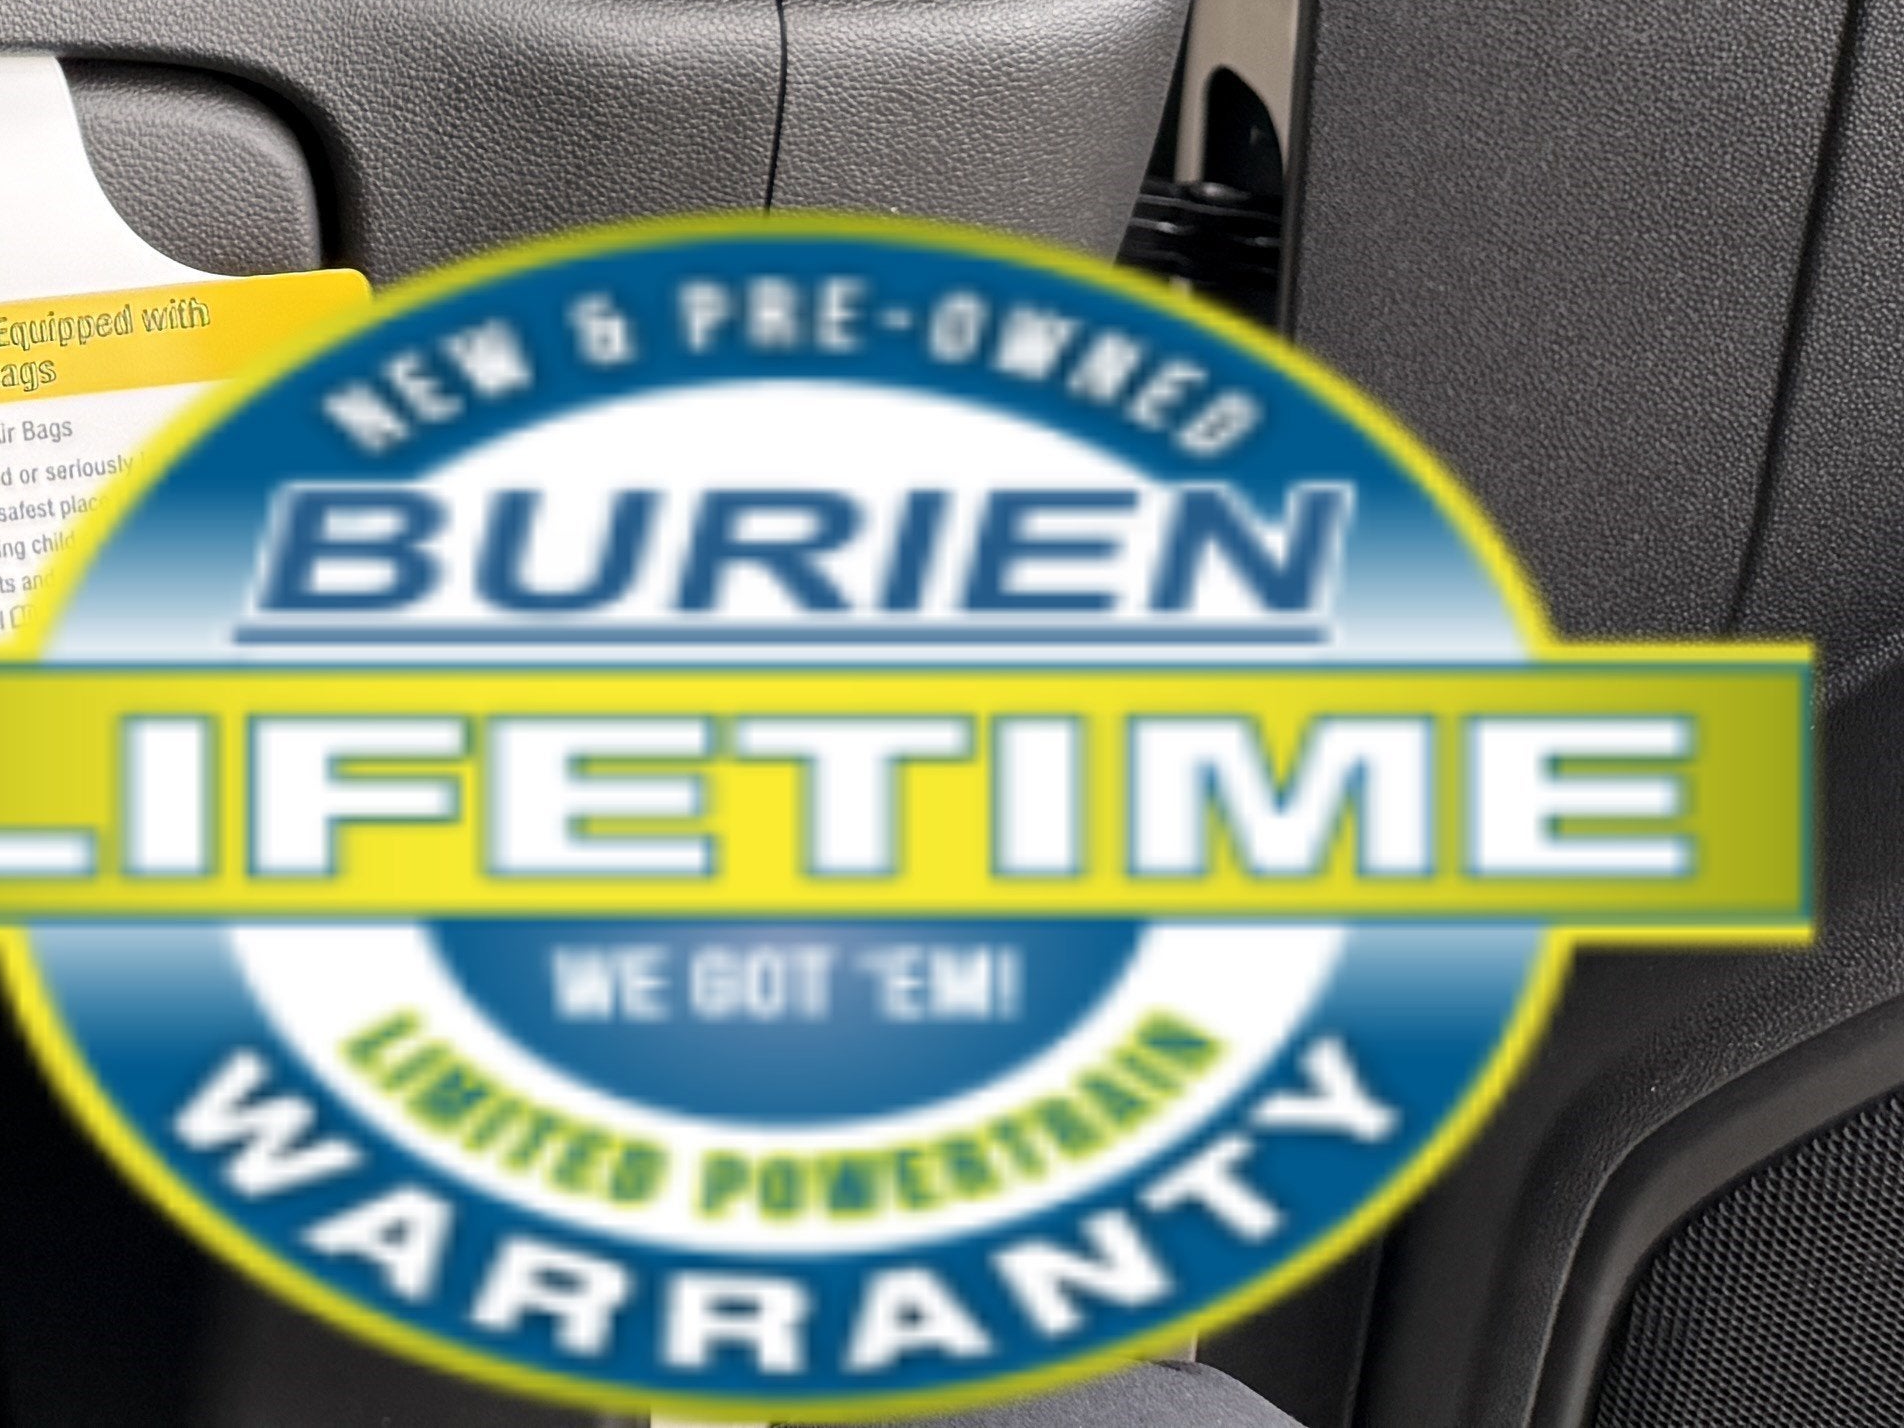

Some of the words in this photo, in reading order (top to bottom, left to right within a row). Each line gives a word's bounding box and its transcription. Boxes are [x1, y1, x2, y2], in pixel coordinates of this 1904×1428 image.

[141, 297, 210, 332] with
[22, 420, 73, 443] Bags
[19, 467, 39, 485] or
[45, 454, 134, 482] seriously
